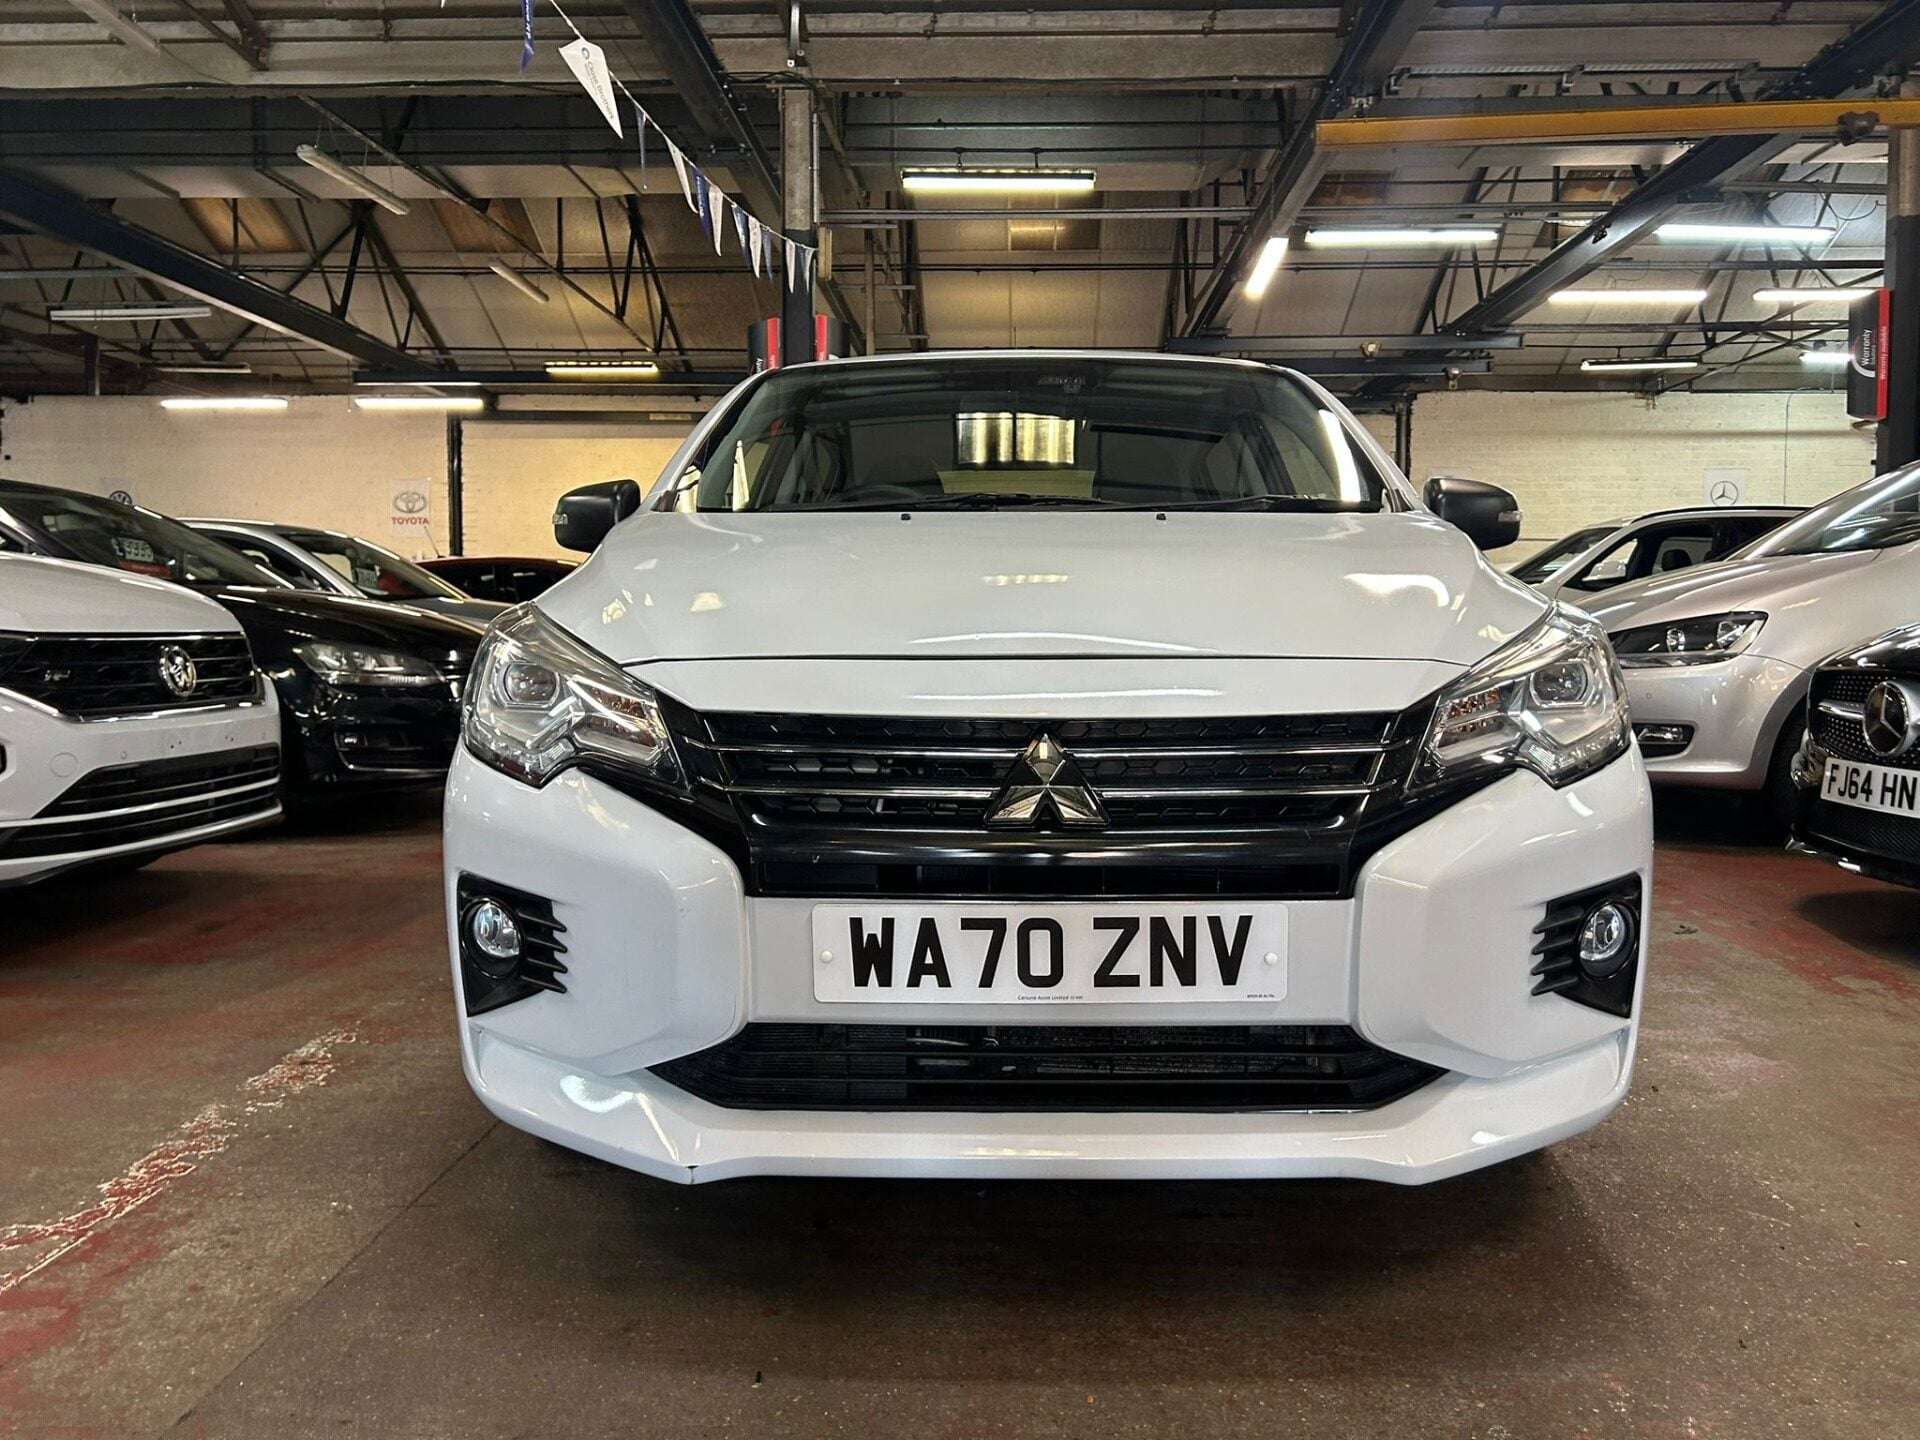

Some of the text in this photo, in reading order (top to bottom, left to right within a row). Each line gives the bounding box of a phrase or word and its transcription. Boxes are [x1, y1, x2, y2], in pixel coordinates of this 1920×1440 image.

[1862, 329, 1873, 366] Warranty
[391, 516, 430, 525] TOYOTA
[1827, 763, 1873, 803] FJ64
[849, 915, 1253, 989] WA70 ZNV
